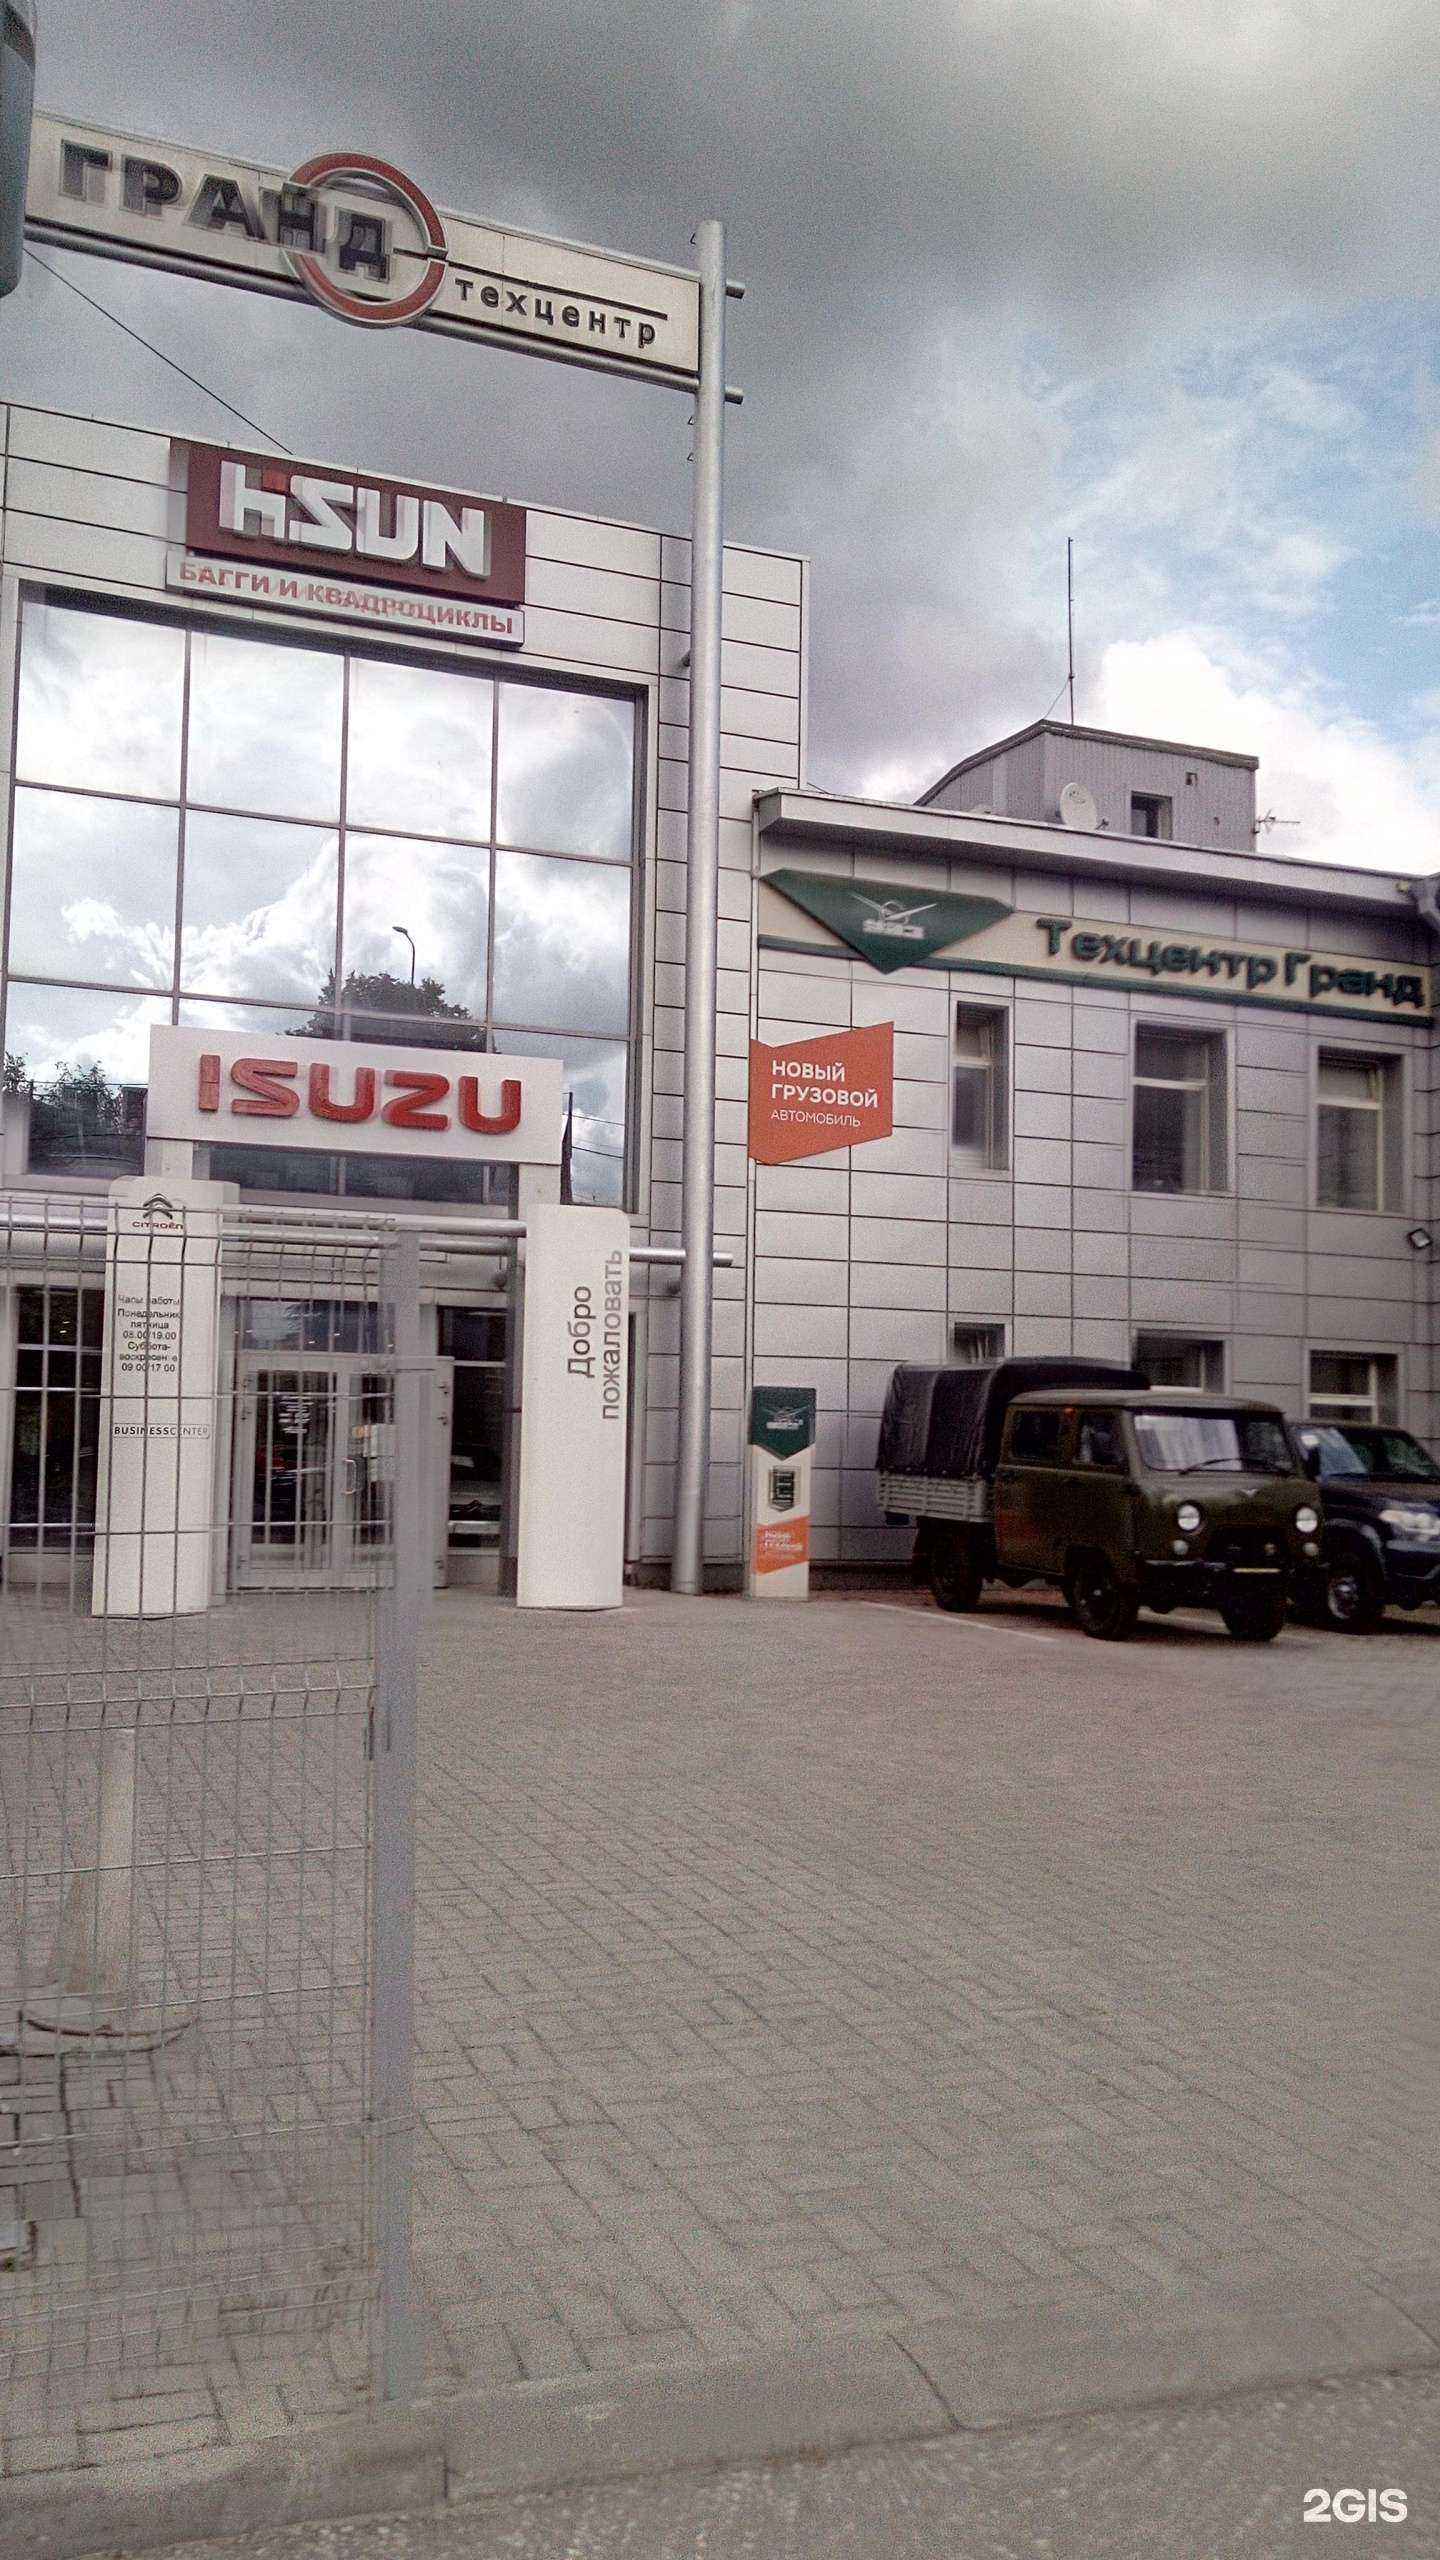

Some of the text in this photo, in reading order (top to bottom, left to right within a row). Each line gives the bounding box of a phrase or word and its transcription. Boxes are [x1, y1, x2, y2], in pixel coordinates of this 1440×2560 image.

[58, 138, 395, 284] ГРАНД
[454, 277, 657, 349] техцентр
[218, 460, 490, 580] HSUN
[179, 562, 514, 635] БАГГИ И КВАДРОЦИКЛЫ
[1036, 917, 1426, 1009] Техцентр Гранд
[198, 1054, 523, 1136] ISUZU
[771, 1060, 846, 1082] НОВЫЙ
[771, 1083, 879, 1108] ГРУЗОВОЙ
[770, 1109, 862, 1128] АВТОМОБИЛЬ
[147, 1296, 180, 1305] аботы
[566, 1286, 597, 1379] Добро
[602, 1249, 623, 1420] пожаловать
